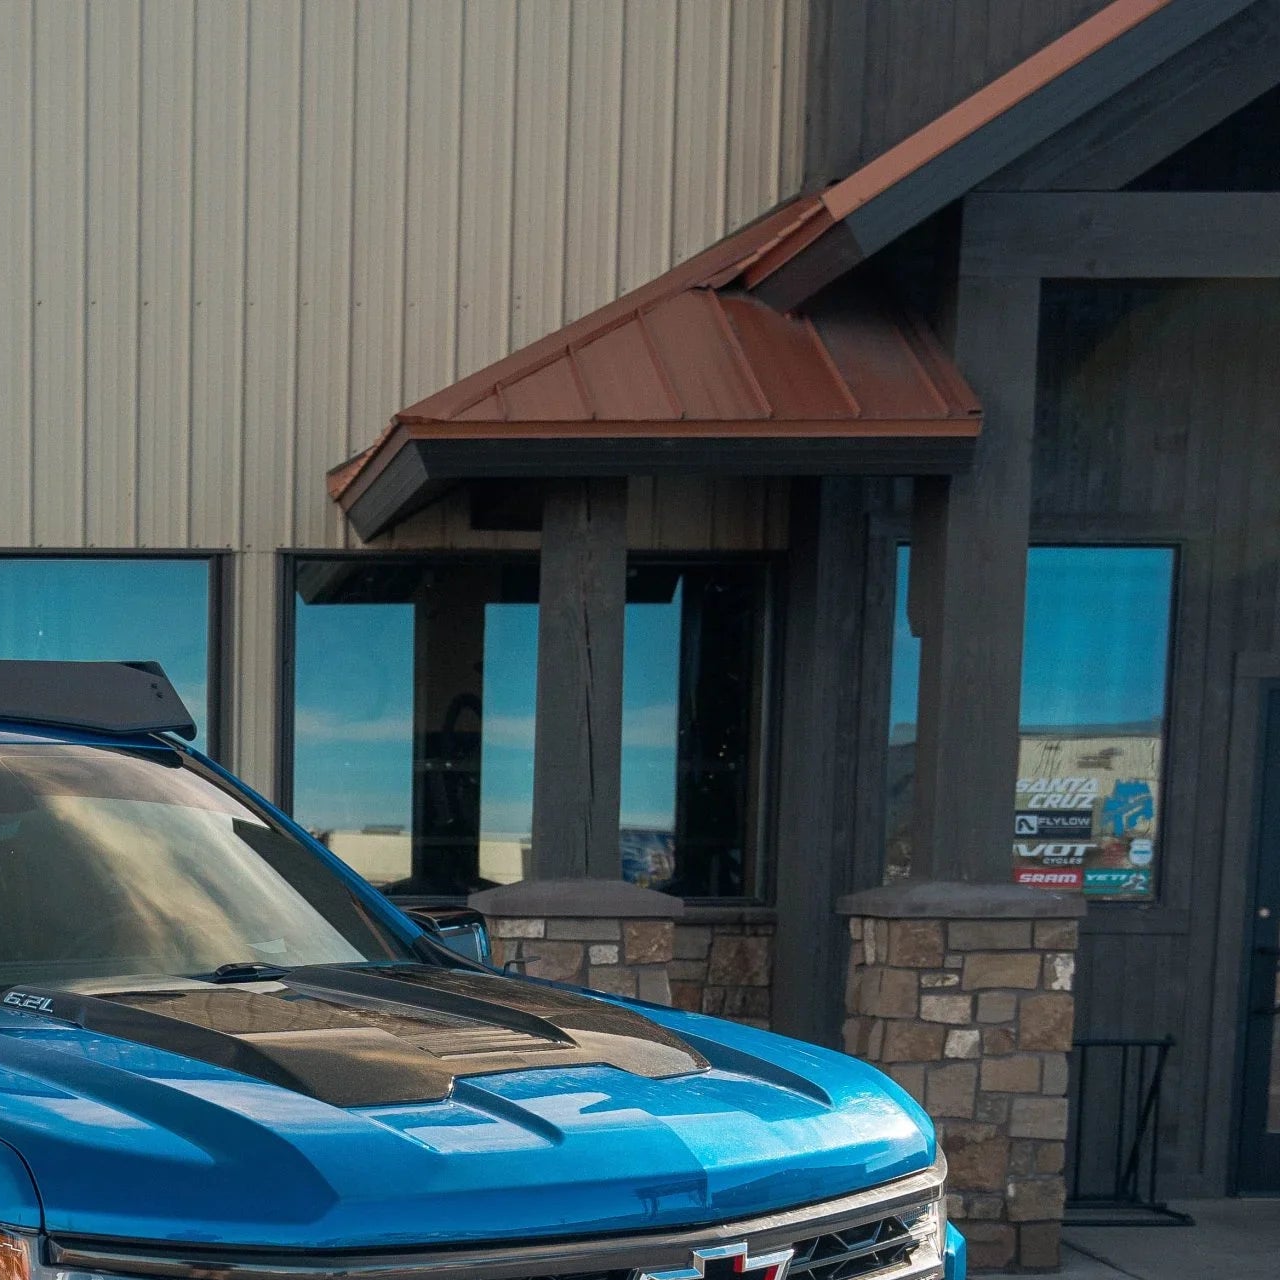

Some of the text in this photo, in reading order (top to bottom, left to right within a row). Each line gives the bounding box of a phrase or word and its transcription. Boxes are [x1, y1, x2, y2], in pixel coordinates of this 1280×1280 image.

[1015, 777, 1099, 793] SANTA
[1028, 793, 1098, 809] CRUZ
[1038, 817, 1090, 826] FLYLOW
[1013, 843, 1097, 857] VOT
[1042, 857, 1083, 865] CYCLES
[1019, 873, 1078, 883] SRAM
